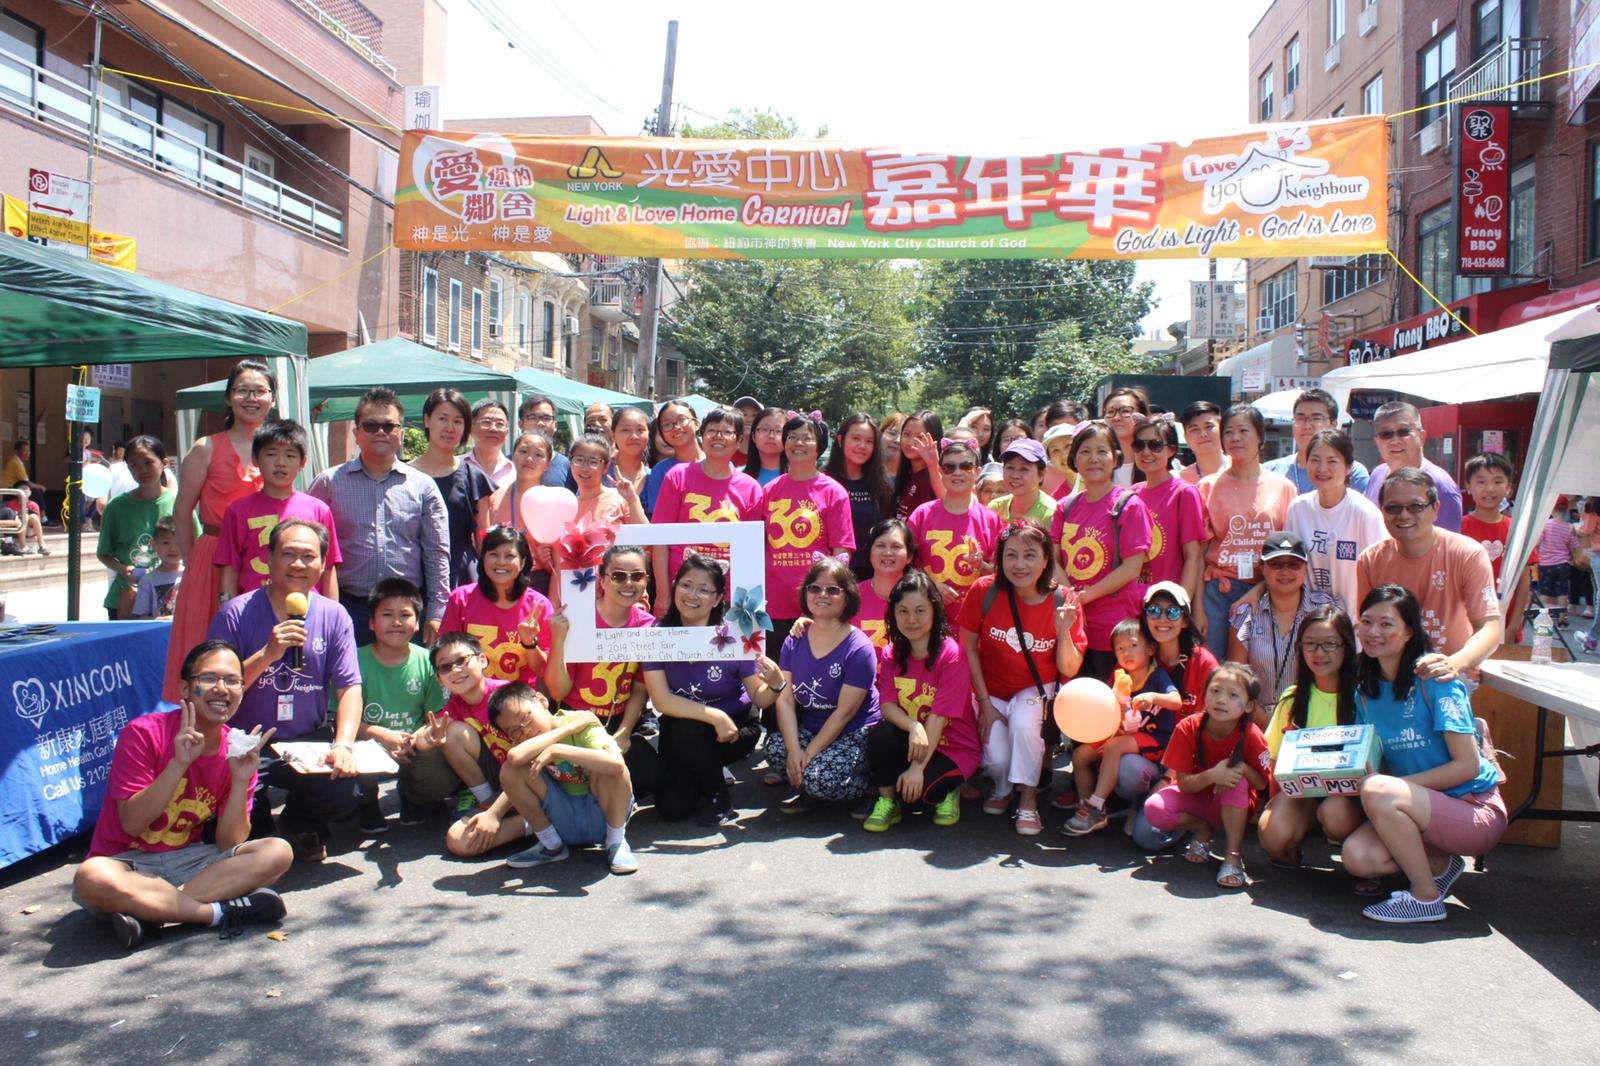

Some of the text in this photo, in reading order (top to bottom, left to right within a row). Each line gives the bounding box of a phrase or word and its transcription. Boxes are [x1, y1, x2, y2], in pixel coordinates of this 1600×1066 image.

[637, 148, 848, 192] 光愛中心
[1190, 161, 1238, 177] Love
[567, 182, 624, 192] NEW YORK
[865, 145, 1162, 228] 嘉年華
[1286, 181, 1363, 201] Neighbour
[566, 206, 611, 225] Light
[616, 207, 628, 222] &
[635, 205, 676, 222] Love
[682, 205, 736, 222] Home
[412, 225, 552, 244] 神是光 神是愛
[1116, 211, 1374, 255] God is Light God is Love
[828, 238, 1027, 250] New York City Church of God
[1470, 240, 1497, 251] BBQ
[1426, 311, 1449, 341] BBQ
[768, 498, 821, 550] 30
[49, 660, 133, 711] XINCON
[41, 761, 67, 777] Home
[43, 780, 70, 801] Call
[69, 775, 87, 791] Us
[1326, 779, 1358, 793] Mor
